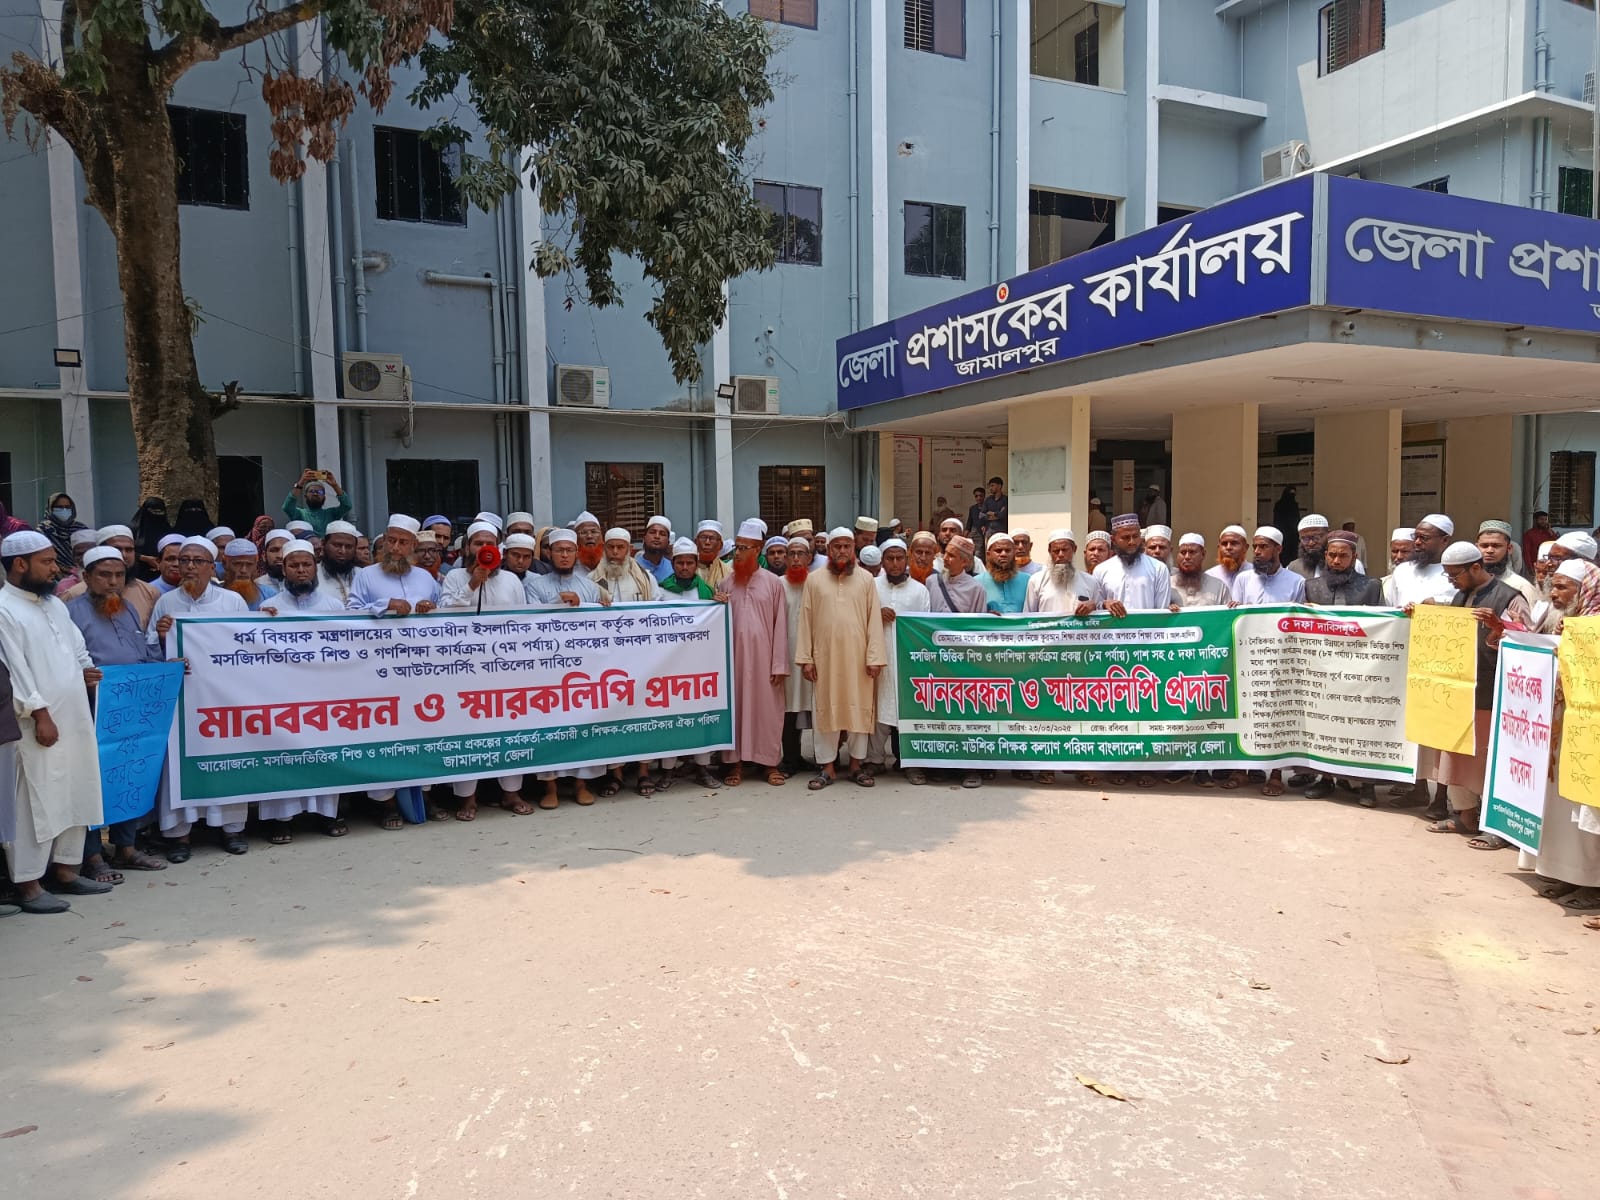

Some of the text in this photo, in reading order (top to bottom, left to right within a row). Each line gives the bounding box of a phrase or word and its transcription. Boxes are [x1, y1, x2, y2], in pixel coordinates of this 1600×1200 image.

[1344, 216, 1495, 279] জেলা
[837, 211, 1305, 389] জেলা প্রশাসকের কার্যালয়
[954, 337, 1058, 378] জামালপুর
[233, 628, 255, 645] ধর্ম
[263, 627, 313, 644] বিষয়ক
[398, 622, 467, 641] আওতাধীন
[473, 619, 532, 636] ইসলামিক
[535, 617, 597, 633] ফাউন্ডেশন
[601, 617, 635, 635] কর্তৃক
[638, 613, 695, 629] পরিচালিত
[210, 647, 316, 667] মসজিদভিত্তিক
[321, 646, 350, 663] শিশু
[356, 648, 369, 660] ও
[374, 644, 430, 659] গণশিক্ষা
[436, 637, 486, 656] কার্যক্রম
[521, 637, 561, 655] পর্যায়)
[564, 634, 609, 651] প্রকল্পের
[613, 631, 651, 647] জনবল
[376, 653, 583, 680] ও আউটসোর্সিং বাতিলের দাবিতে
[909, 648, 936, 662] মসজিদ
[1132, 648, 1149, 662] পাশ
[1152, 648, 1166, 662] সহ
[1178, 647, 1196, 660] দফা
[1199, 644, 1228, 659] দাবিতে
[197, 668, 719, 739] মানববন্ধন ও স্মারকলিপি প্রদান
[909, 664, 1231, 714] মানববন্ধন ও স্মারকলিপি প্রদান
[197, 757, 260, 774] আয়োজনে:
[341, 747, 363, 762] শিশু
[366, 748, 376, 760] ও
[423, 737, 461, 753] কার্যক্রম
[582, 728, 590, 739] ও
[443, 747, 536, 769] জামালপুর জেলা
[911, 739, 959, 754] আয়োজনে:
[962, 737, 996, 755] মউশিক
[998, 737, 1028, 756] শিক্ষক
[1030, 741, 1061, 756] কল্যাণ
[1063, 738, 1095, 757] পরিষদ
[1151, 740, 1197, 759] জামালপুর
